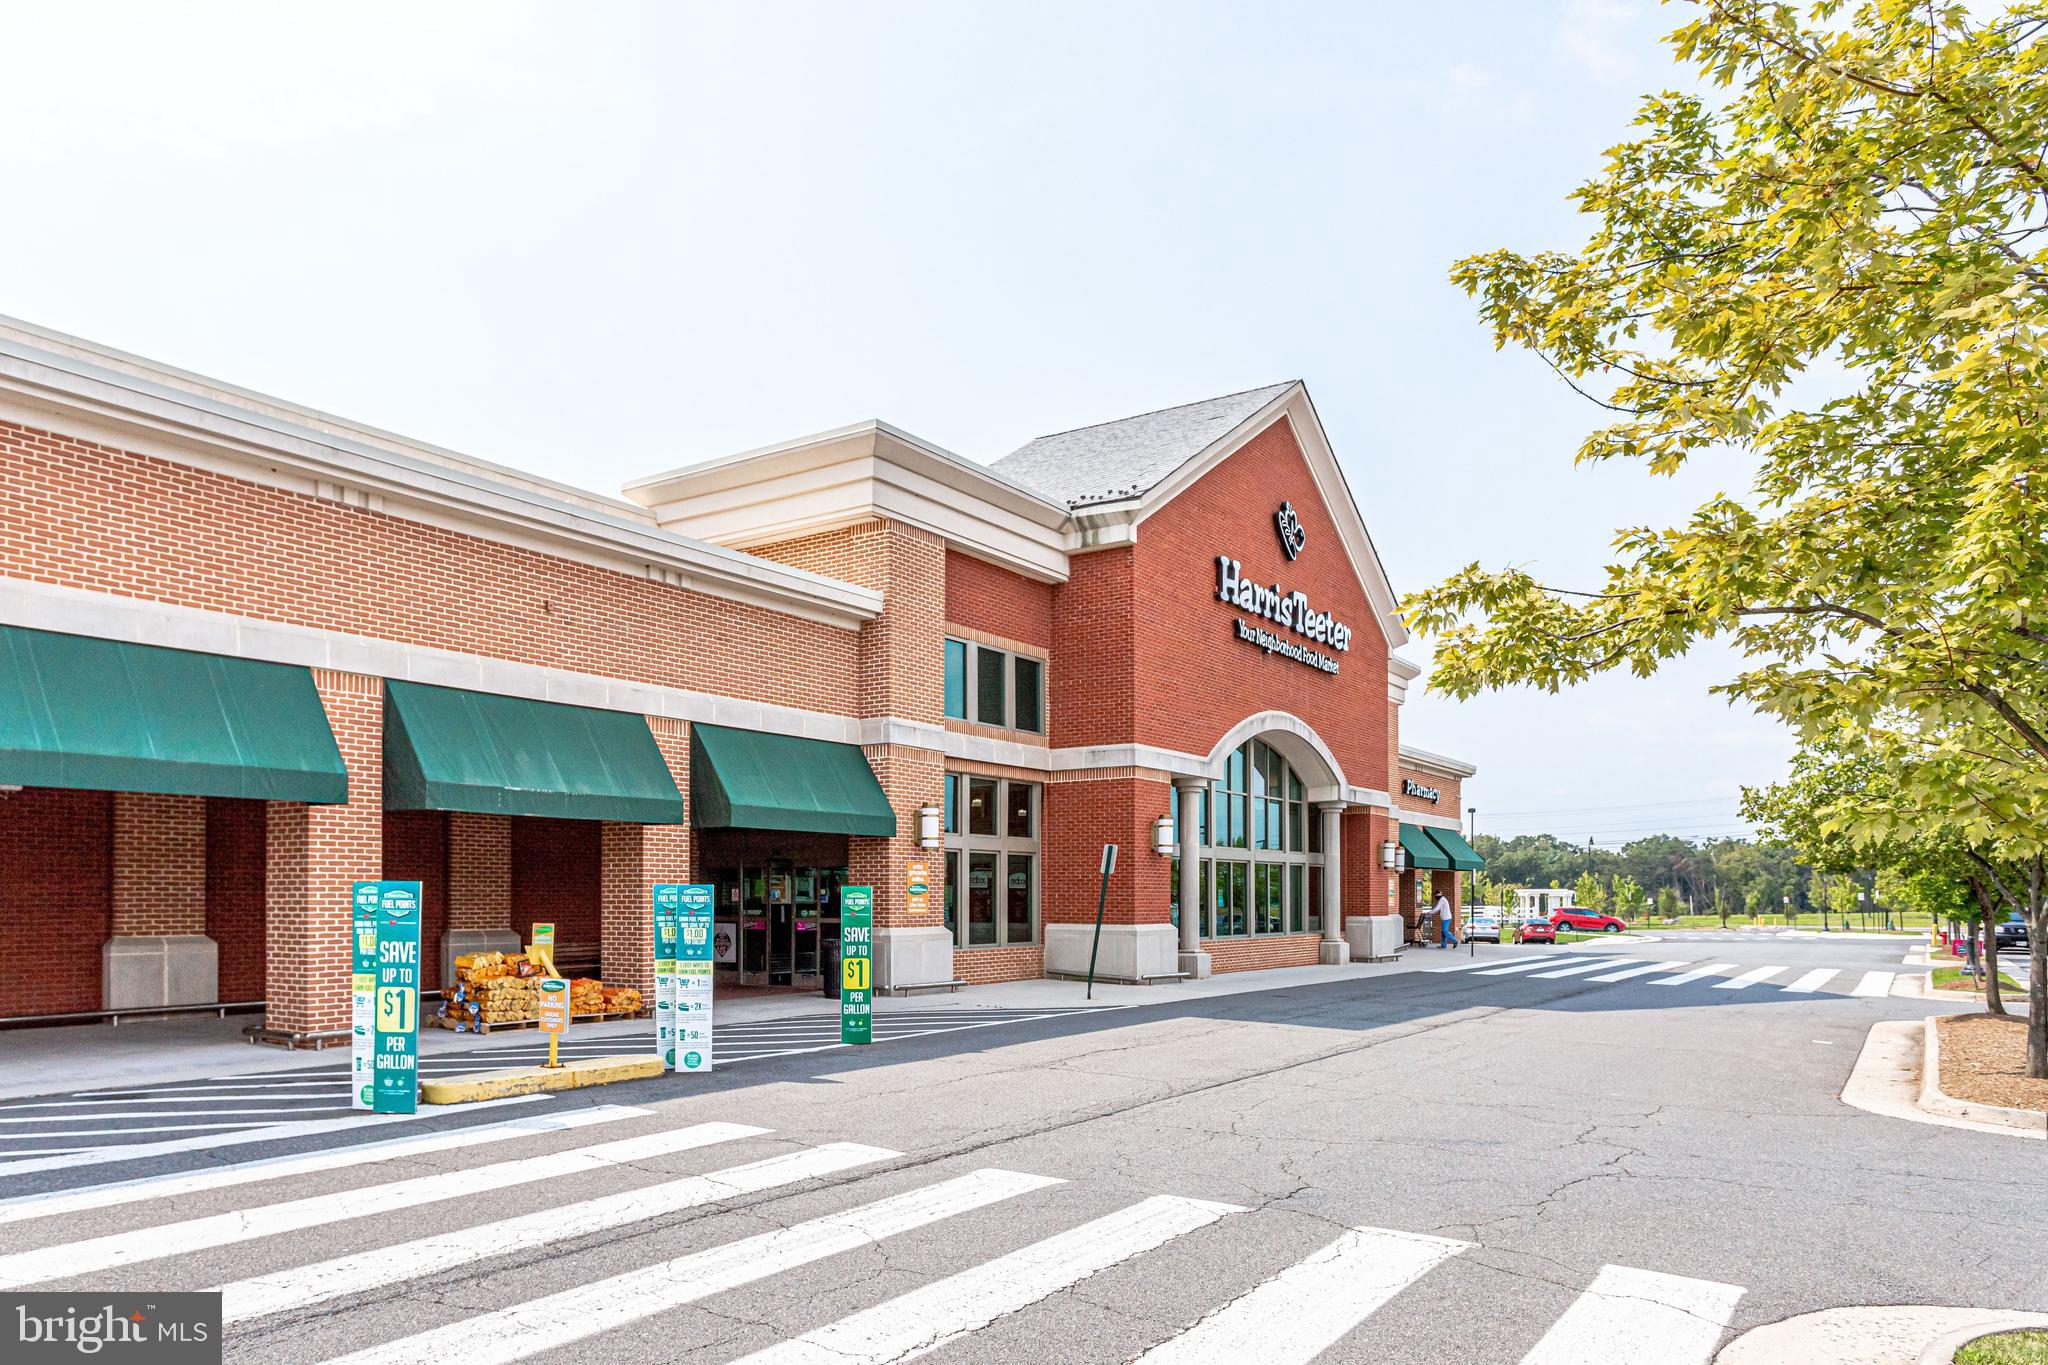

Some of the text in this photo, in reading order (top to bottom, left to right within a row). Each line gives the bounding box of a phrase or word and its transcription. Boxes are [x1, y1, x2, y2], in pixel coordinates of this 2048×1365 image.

[1220, 555, 1352, 652] Harris Teeter
[1238, 618, 1340, 675] Your Neighborhood Food Market
[1406, 778, 1441, 805] Pharmacy
[381, 899, 417, 909] FUEL POINTS
[657, 894, 669, 903] FUEL
[681, 895, 711, 903] FUEL POINTS
[844, 898, 869, 906] FUEL POINTS
[844, 926, 870, 943] SAVE
[379, 941, 417, 964] SAVE
[846, 945, 868, 956] UP TO
[382, 967, 413, 983] UP TO
[847, 959, 863, 988] $1
[850, 991, 864, 1003] PER
[384, 988, 406, 1030] $1
[843, 1003, 870, 1015] GALLON
[690, 1030, 699, 1040] 50
[386, 1036, 406, 1052] PER
[376, 1053, 415, 1070] GALLON
